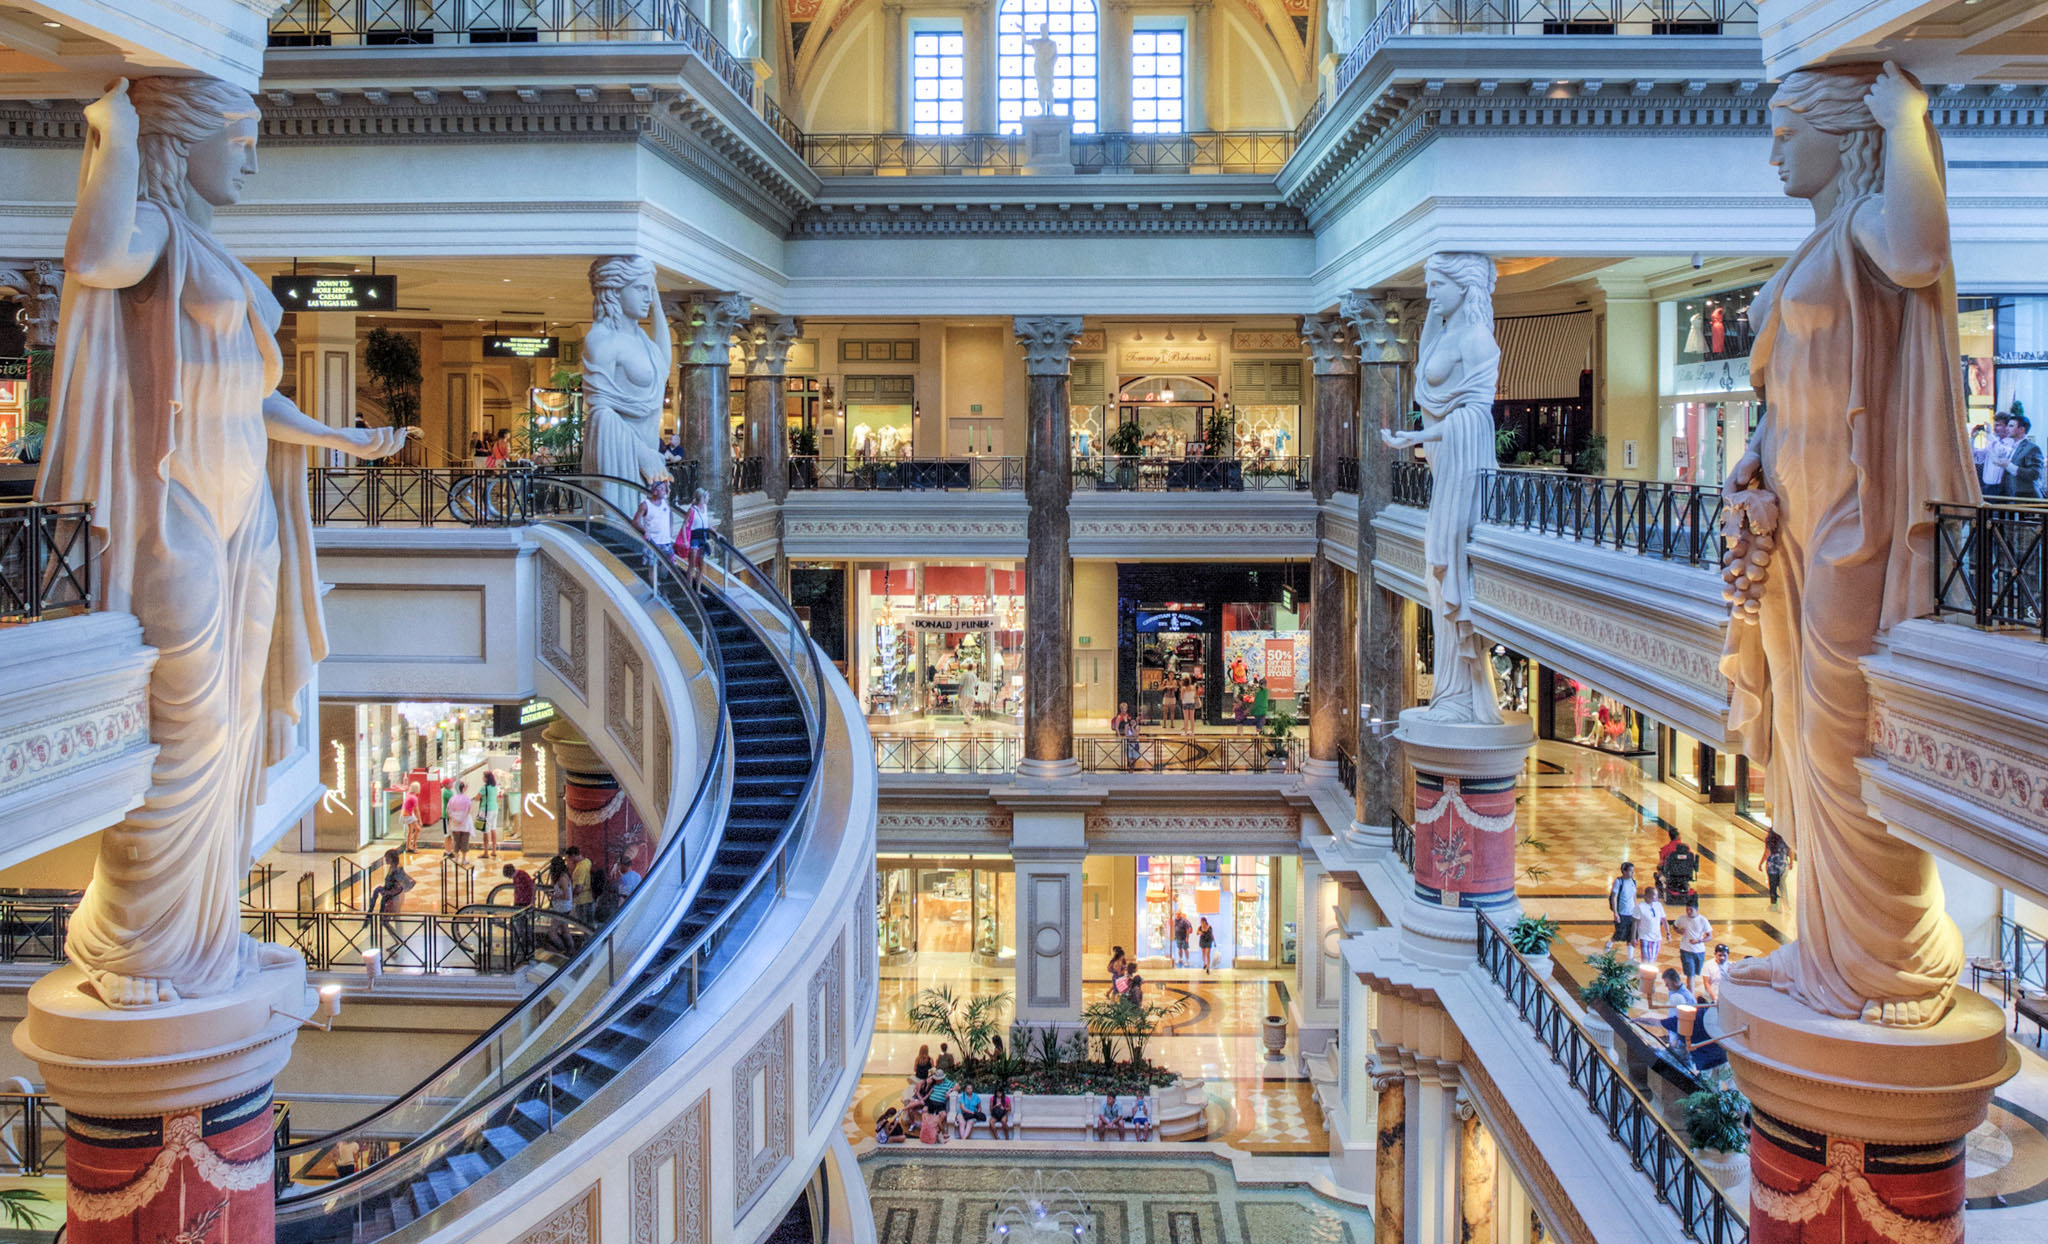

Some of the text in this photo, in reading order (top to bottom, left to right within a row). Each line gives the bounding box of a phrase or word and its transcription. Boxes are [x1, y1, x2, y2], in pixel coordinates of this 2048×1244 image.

[307, 299, 319, 307] LAS
[319, 299, 339, 307] VEGAS
[1126, 351, 1160, 365] Tommy
[915, 620, 989, 630] DONALD J PLINER
[1142, 613, 1171, 626] CHRISTIAN
[1267, 649, 1292, 660] 50%
[520, 707, 554, 725] RESTAURANTS
[323, 739, 354, 816] Baccarat
[524, 743, 555, 819] Baccarat
